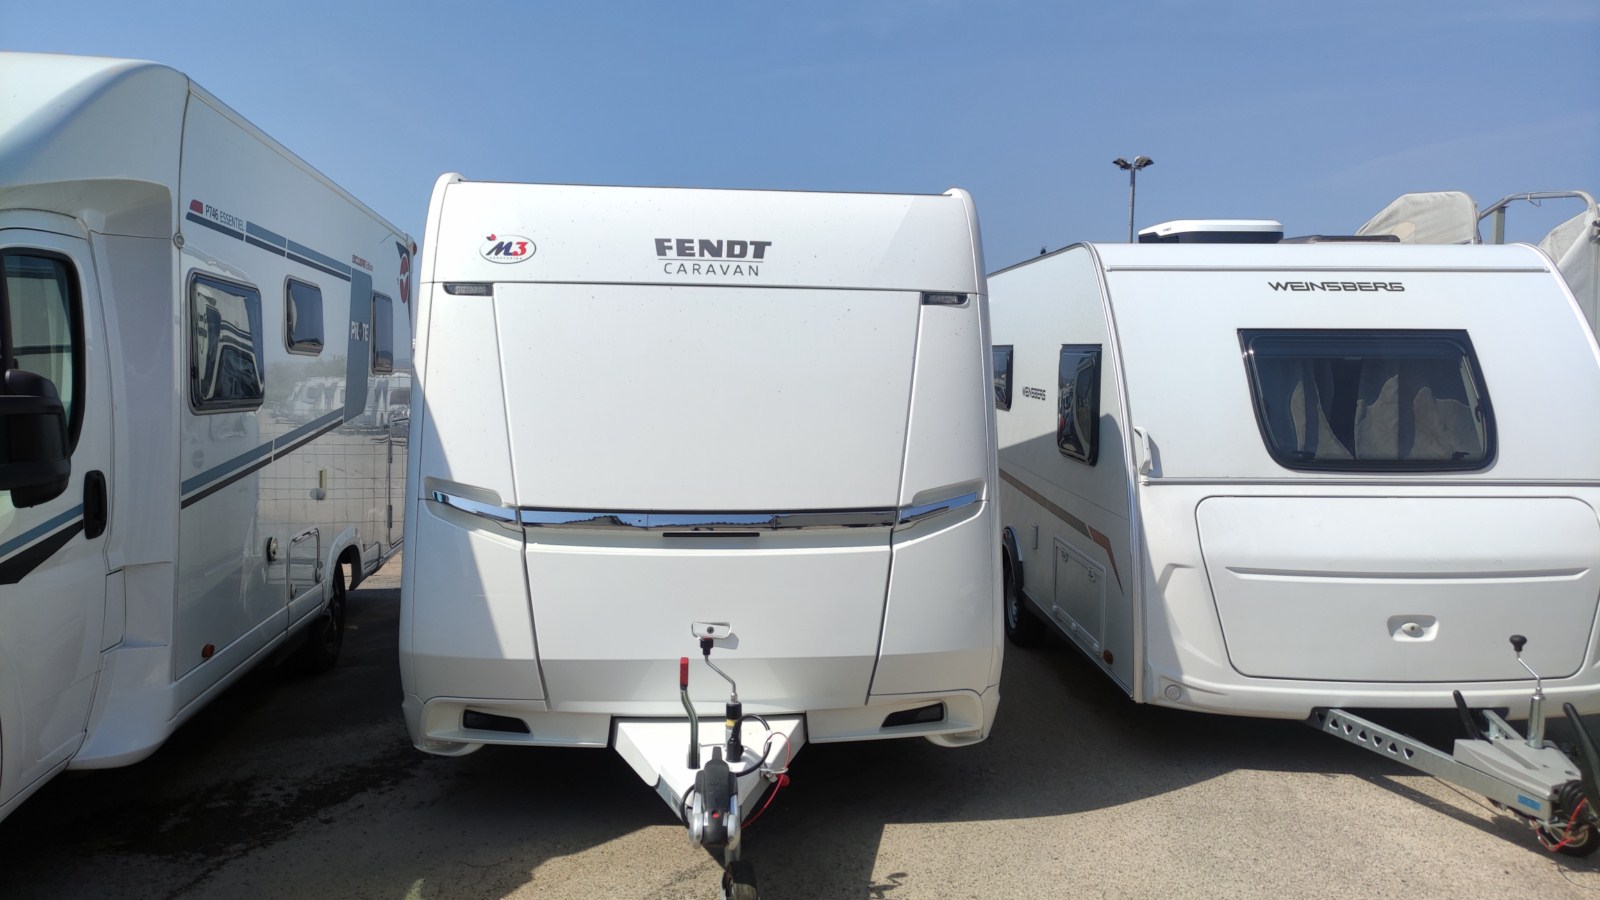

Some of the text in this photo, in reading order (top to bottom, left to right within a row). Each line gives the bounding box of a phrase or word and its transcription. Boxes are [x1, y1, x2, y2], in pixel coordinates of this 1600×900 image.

[205, 204, 245, 231] P746 ESSENTIEL
[654, 238, 772, 259] FENDT
[664, 262, 759, 276] CARAVAN
[1268, 281, 1405, 292] WEINSBERG
